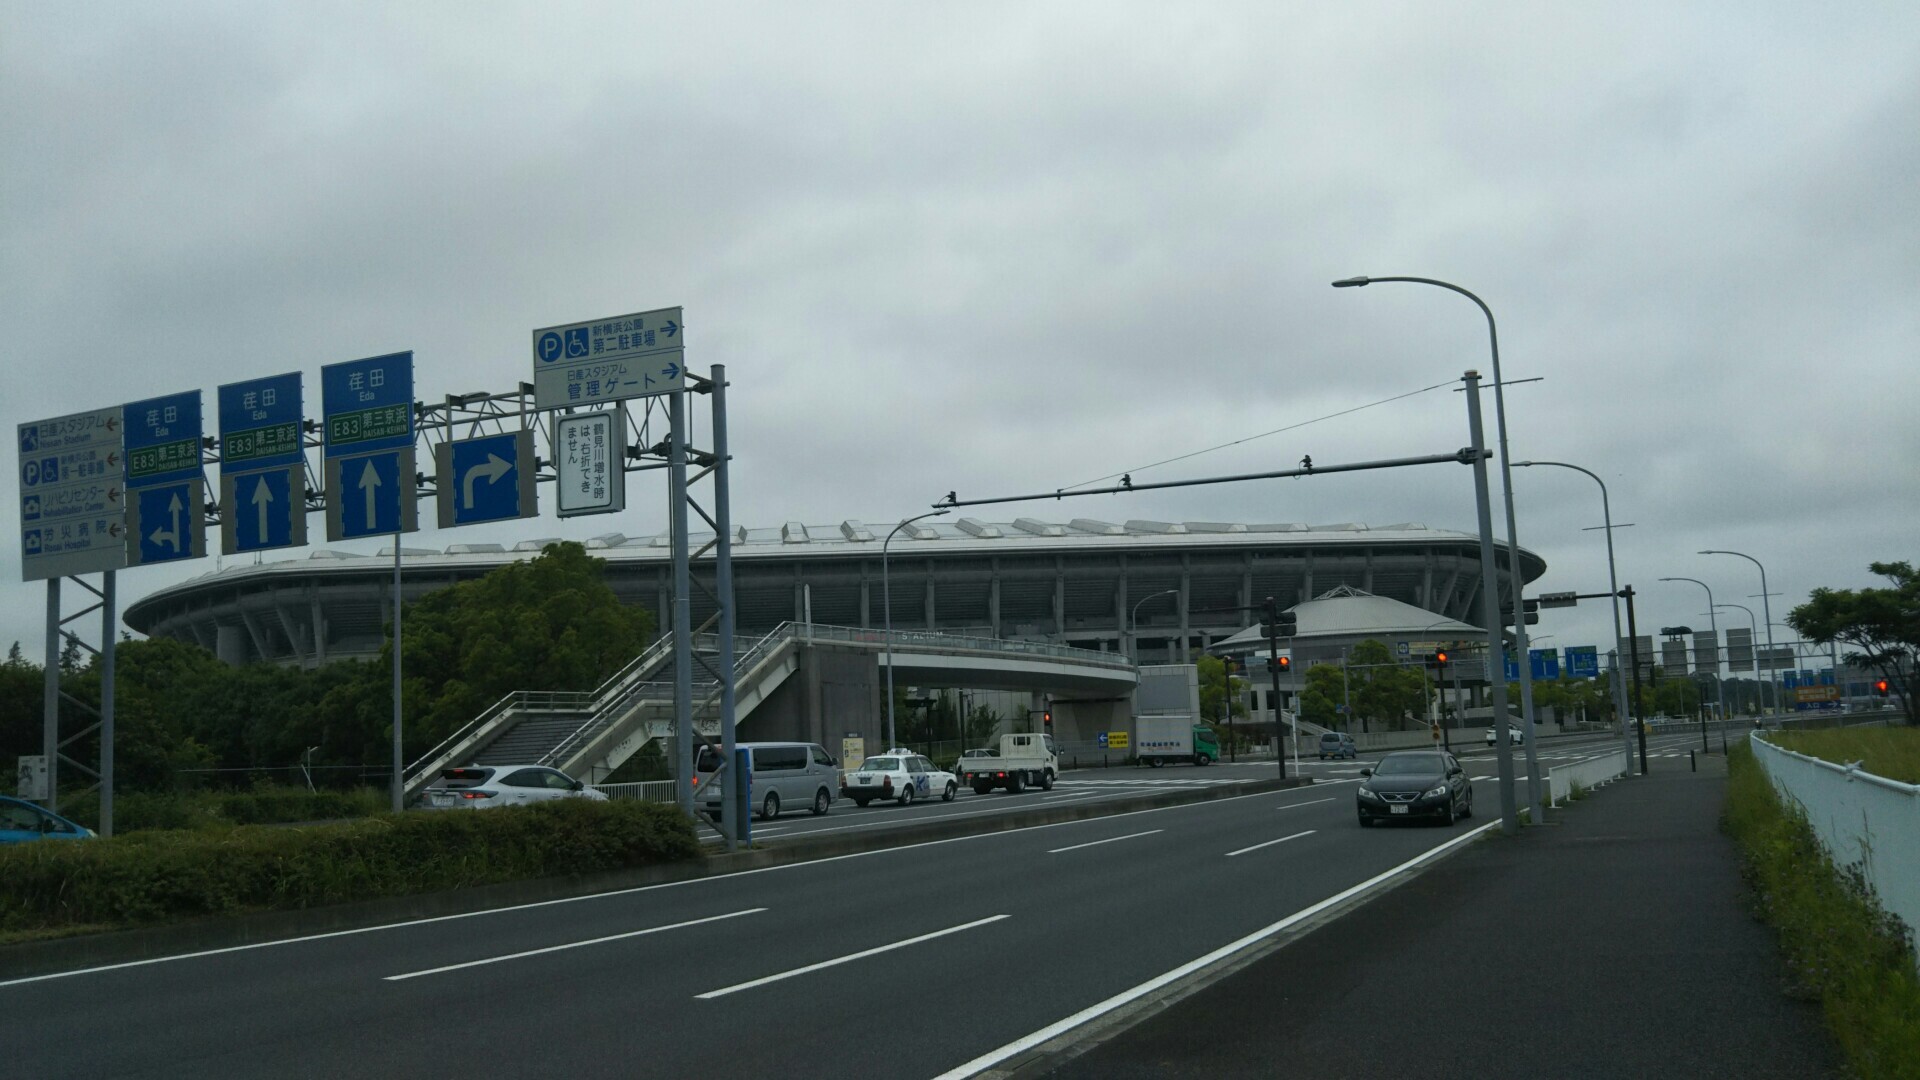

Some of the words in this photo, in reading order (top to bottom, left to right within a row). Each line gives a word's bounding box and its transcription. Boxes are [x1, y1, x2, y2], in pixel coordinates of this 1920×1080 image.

[592, 318, 644, 336] 新横浜公園
[593, 329, 656, 355] 第二駐車場
[349, 368, 384, 391] 荏田
[567, 362, 627, 382] 日産スタジアム
[359, 391, 375, 402] Eda
[567, 373, 656, 400] 管理ゲート
[252, 410, 267, 421] Eda
[363, 406, 407, 428] 第三京浜
[39, 415, 105, 438] 日産スタジアム
[155, 427, 169, 437] Eda
[255, 425, 297, 446] 第三京浜
[334, 420, 359, 437] E83
[363, 424, 407, 439] DAISAN-KEIHIN
[158, 441, 196, 461] 第三京浜
[229, 438, 252, 454] E83
[567, 426, 578, 465] ません
[133, 454, 155, 470] E83
[593, 422, 605, 500] 鶴見川増水時
